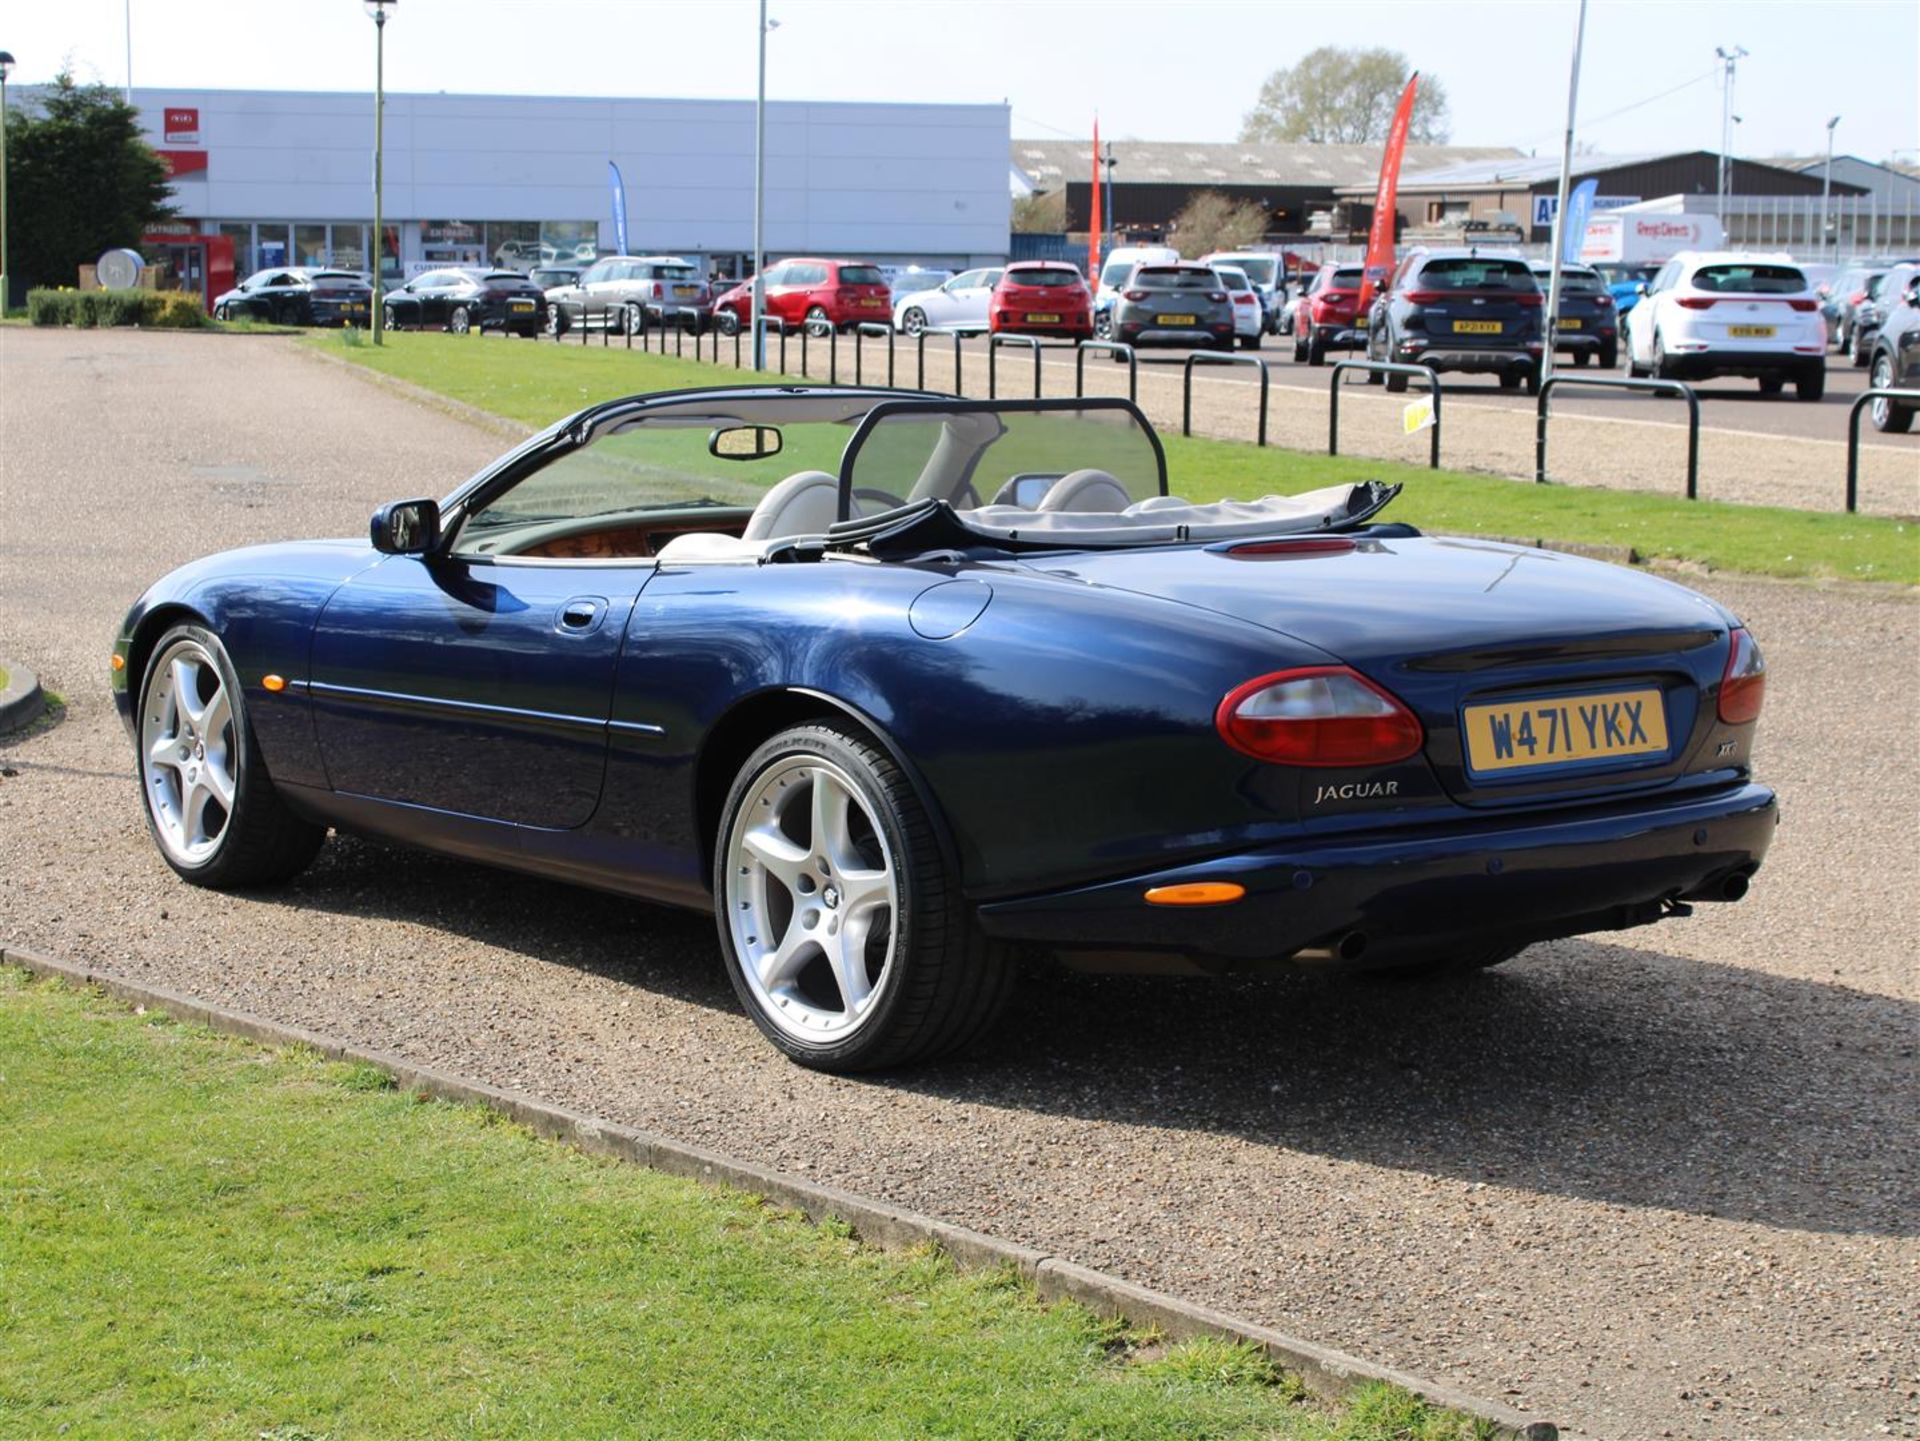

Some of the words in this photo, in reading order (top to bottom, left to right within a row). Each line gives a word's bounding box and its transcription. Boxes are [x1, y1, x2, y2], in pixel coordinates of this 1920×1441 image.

[1489, 706, 1573, 760] W471
[1579, 700, 1648, 750] YKX
[1314, 780, 1399, 804] JAGUAR
